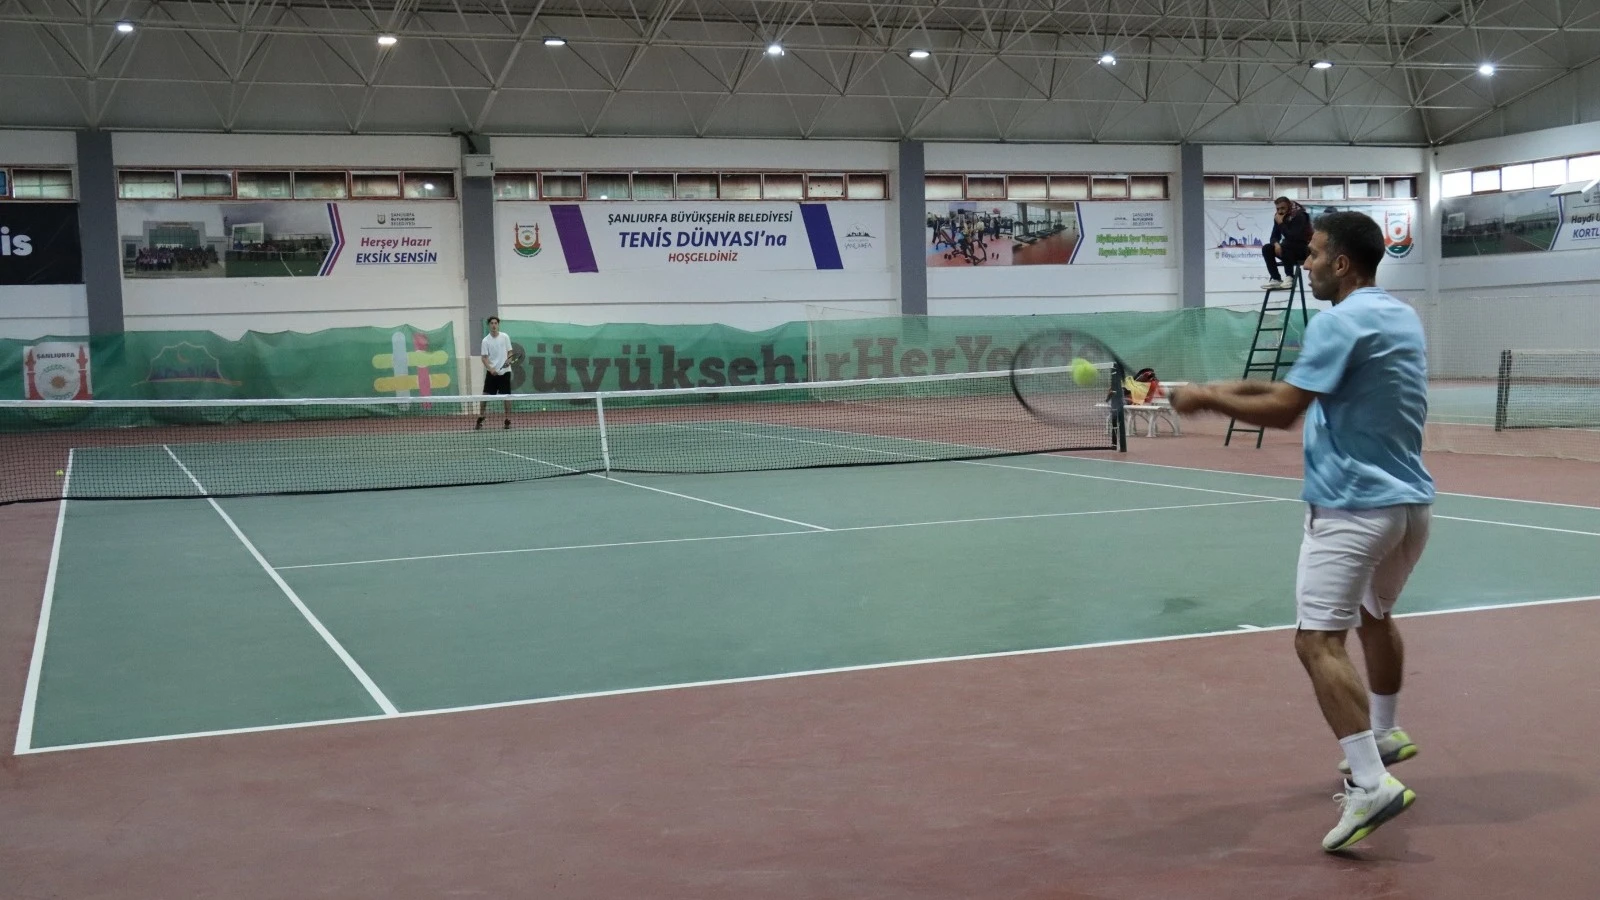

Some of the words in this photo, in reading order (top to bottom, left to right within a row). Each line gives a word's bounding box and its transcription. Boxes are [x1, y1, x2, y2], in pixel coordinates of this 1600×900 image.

[608, 213, 668, 225] ŞANLIURFA
[670, 211, 735, 225] BÜYÜKŞEHİR
[737, 211, 793, 223] BELEDİYESİ
[1571, 213, 1594, 225] Haydi
[361, 237, 398, 249] Herşey
[401, 237, 432, 247] Hazır
[619, 227, 672, 248] TENİS
[676, 227, 787, 247] DÜNYASI'na
[356, 250, 391, 263] EKSİK
[393, 250, 437, 263] SENSİN
[668, 250, 738, 264] HOŞGELDİNİZ
